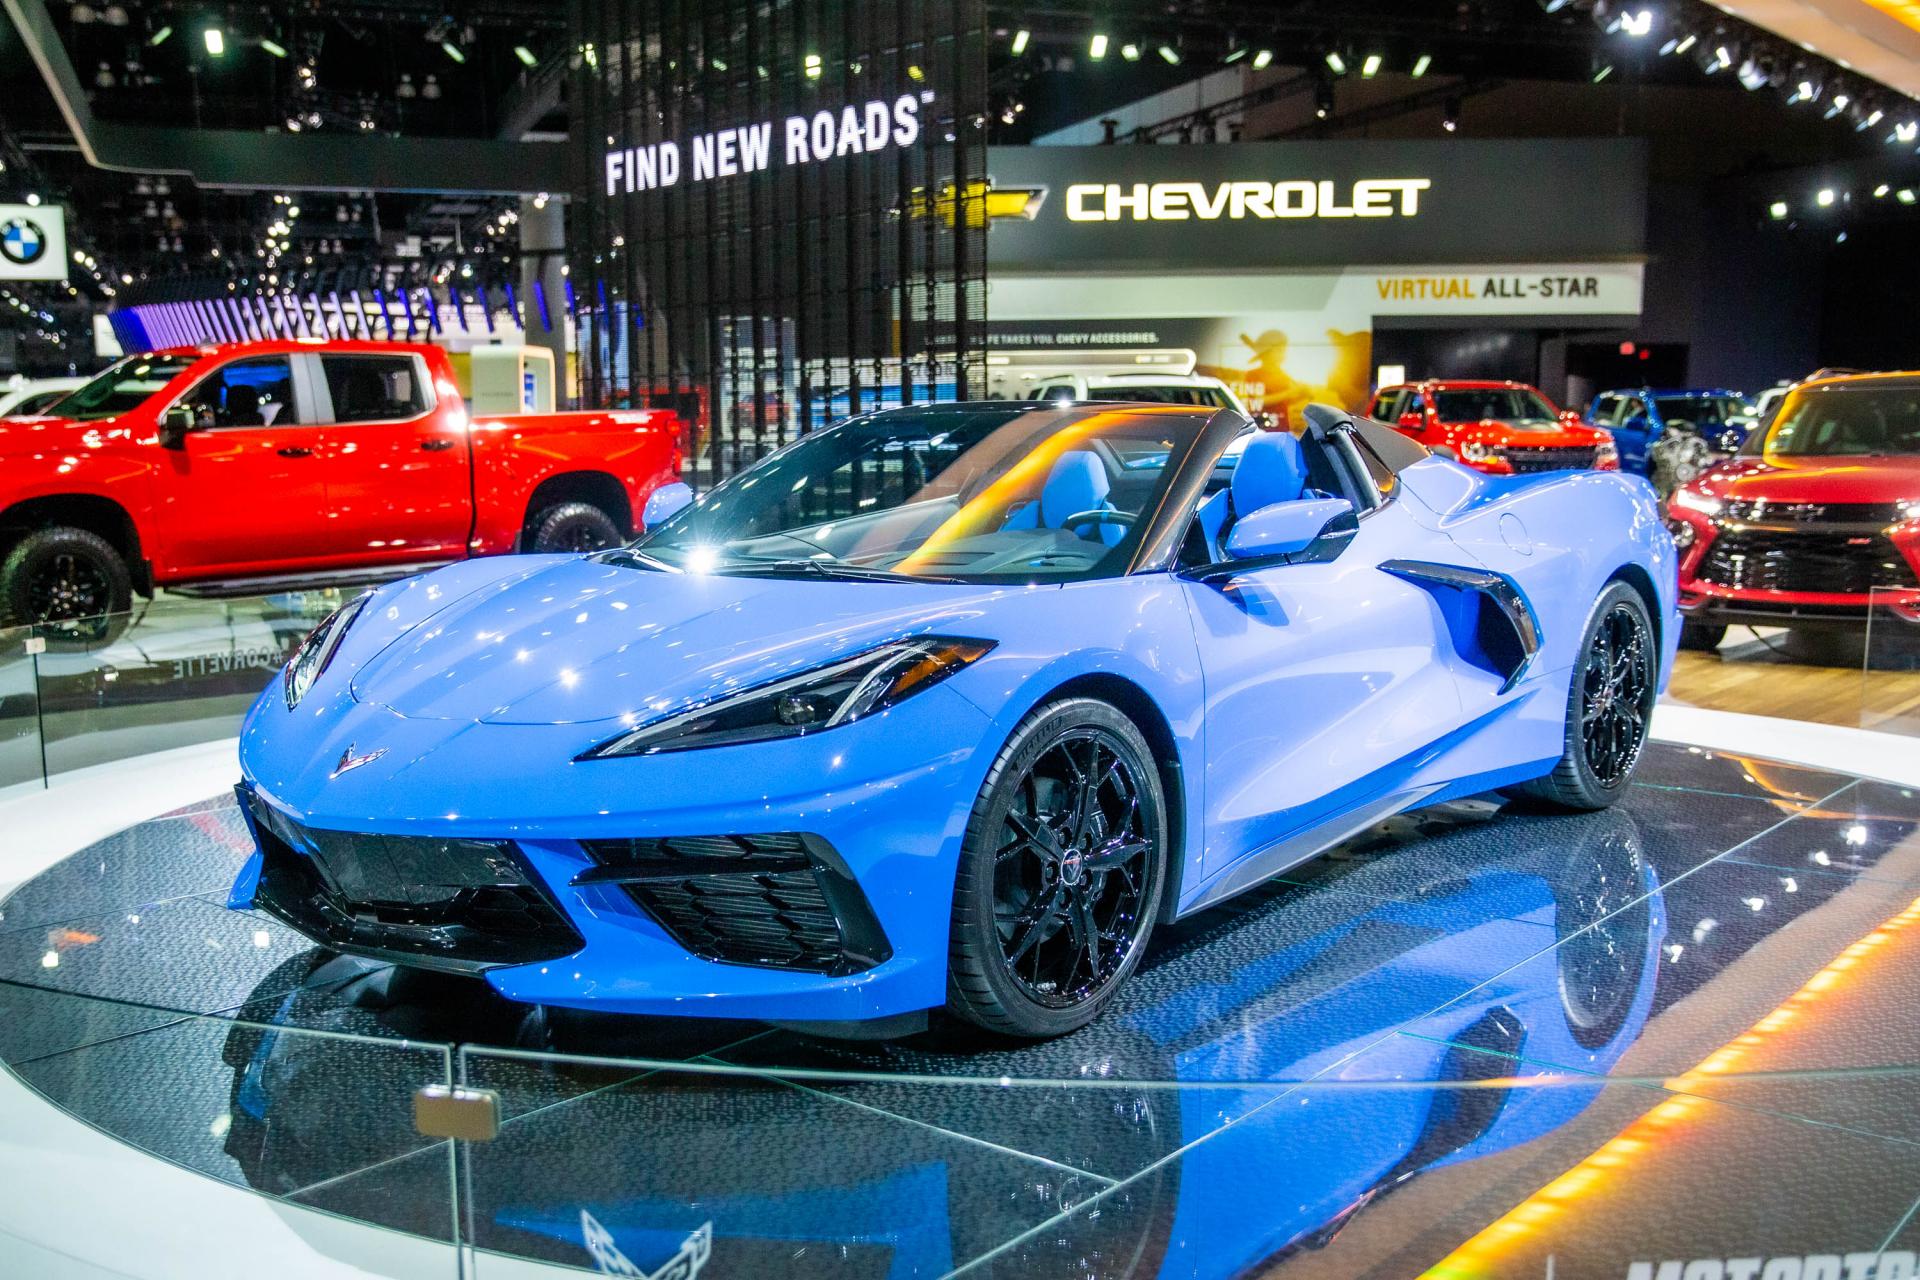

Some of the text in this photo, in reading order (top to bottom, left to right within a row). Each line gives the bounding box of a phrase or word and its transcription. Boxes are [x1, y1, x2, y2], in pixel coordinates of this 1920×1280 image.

[605, 141, 680, 196] FIND
[693, 121, 772, 181] NEW
[1066, 178, 1431, 221] CHEVROLET
[1377, 276, 1598, 300] VIRTUAL ALL-STAR
[1001, 334, 1031, 345] TAKES
[1056, 333, 1089, 344] CHEVY
